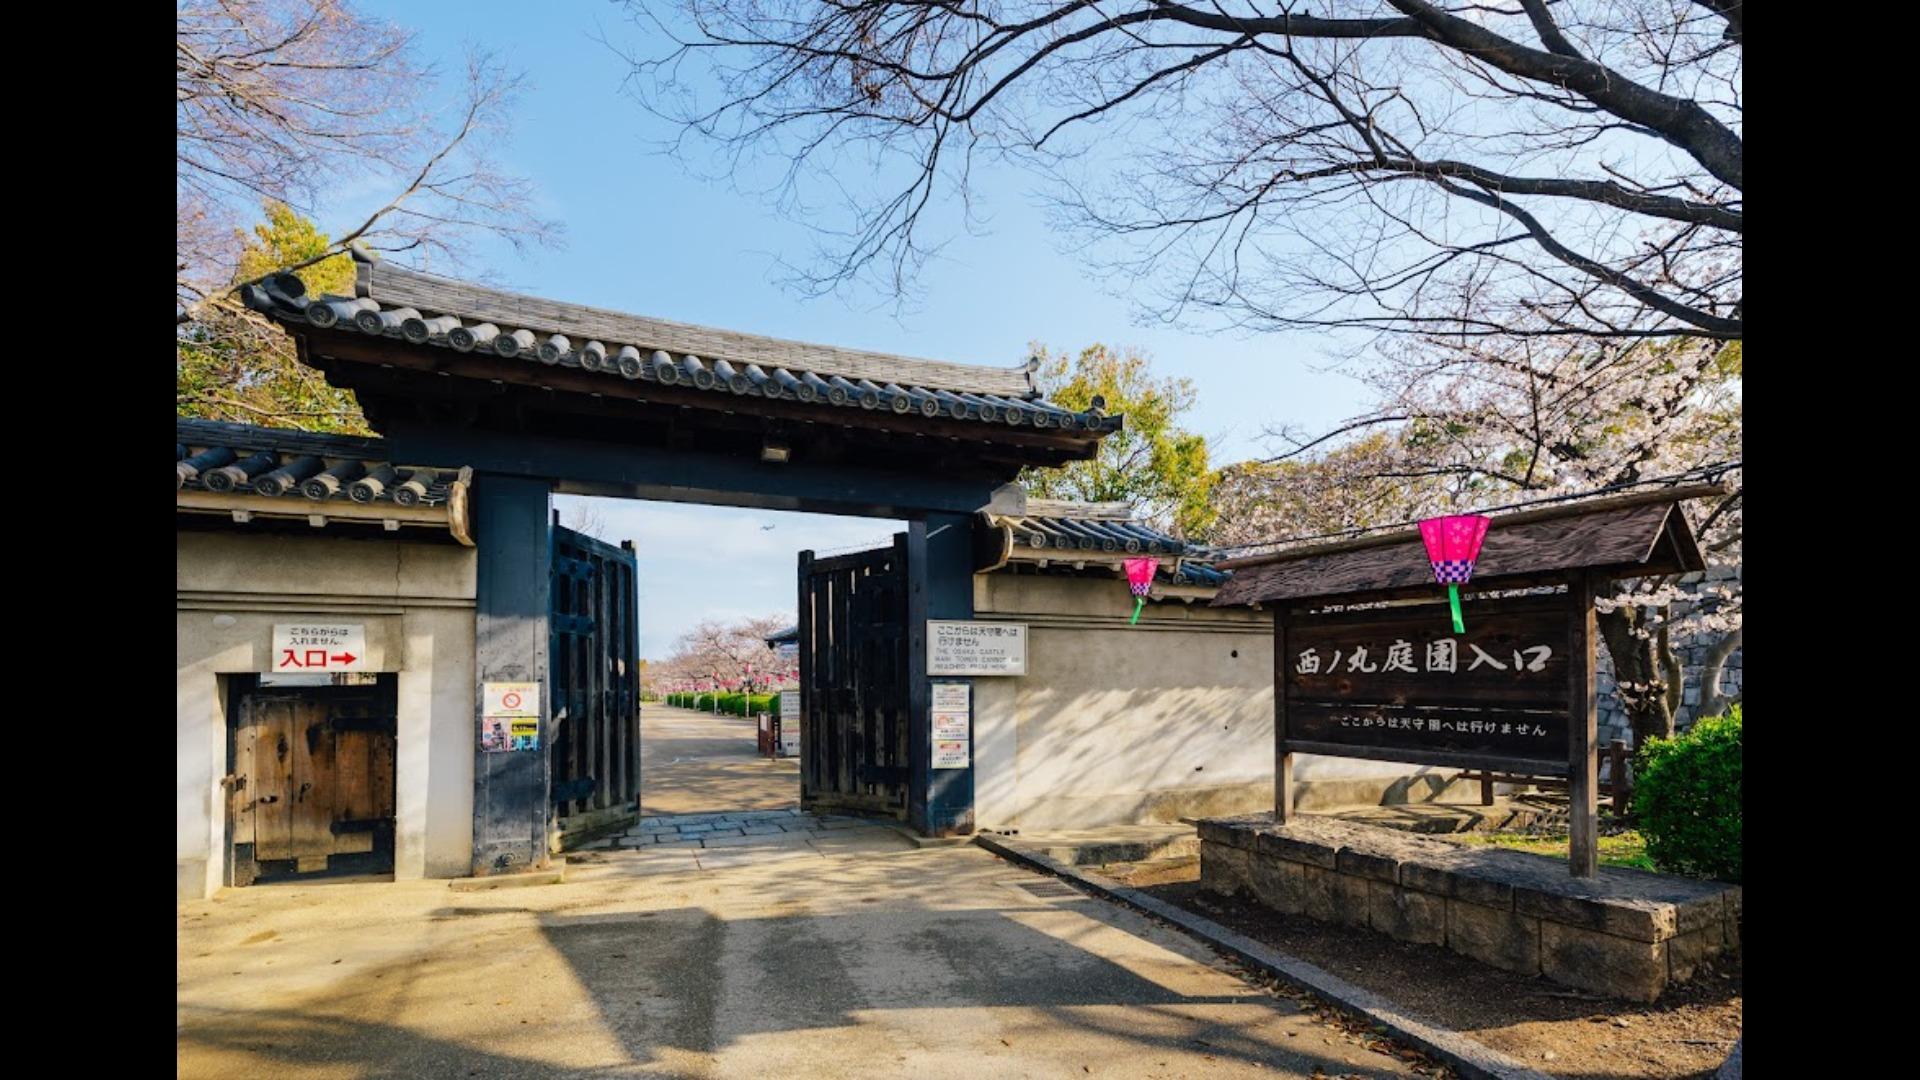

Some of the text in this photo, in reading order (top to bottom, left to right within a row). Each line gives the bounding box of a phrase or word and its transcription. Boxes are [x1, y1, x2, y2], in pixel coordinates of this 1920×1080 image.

[290, 627, 348, 636] こちらからは
[937, 625, 1018, 637] ここからは天守閣へは
[938, 636, 980, 647] 行けません
[280, 649, 327, 667] 入口
[1295, 638, 1553, 675] 西ノ丸庭園入口
[1340, 716, 1547, 737] ここからは天守閣へは行けません
